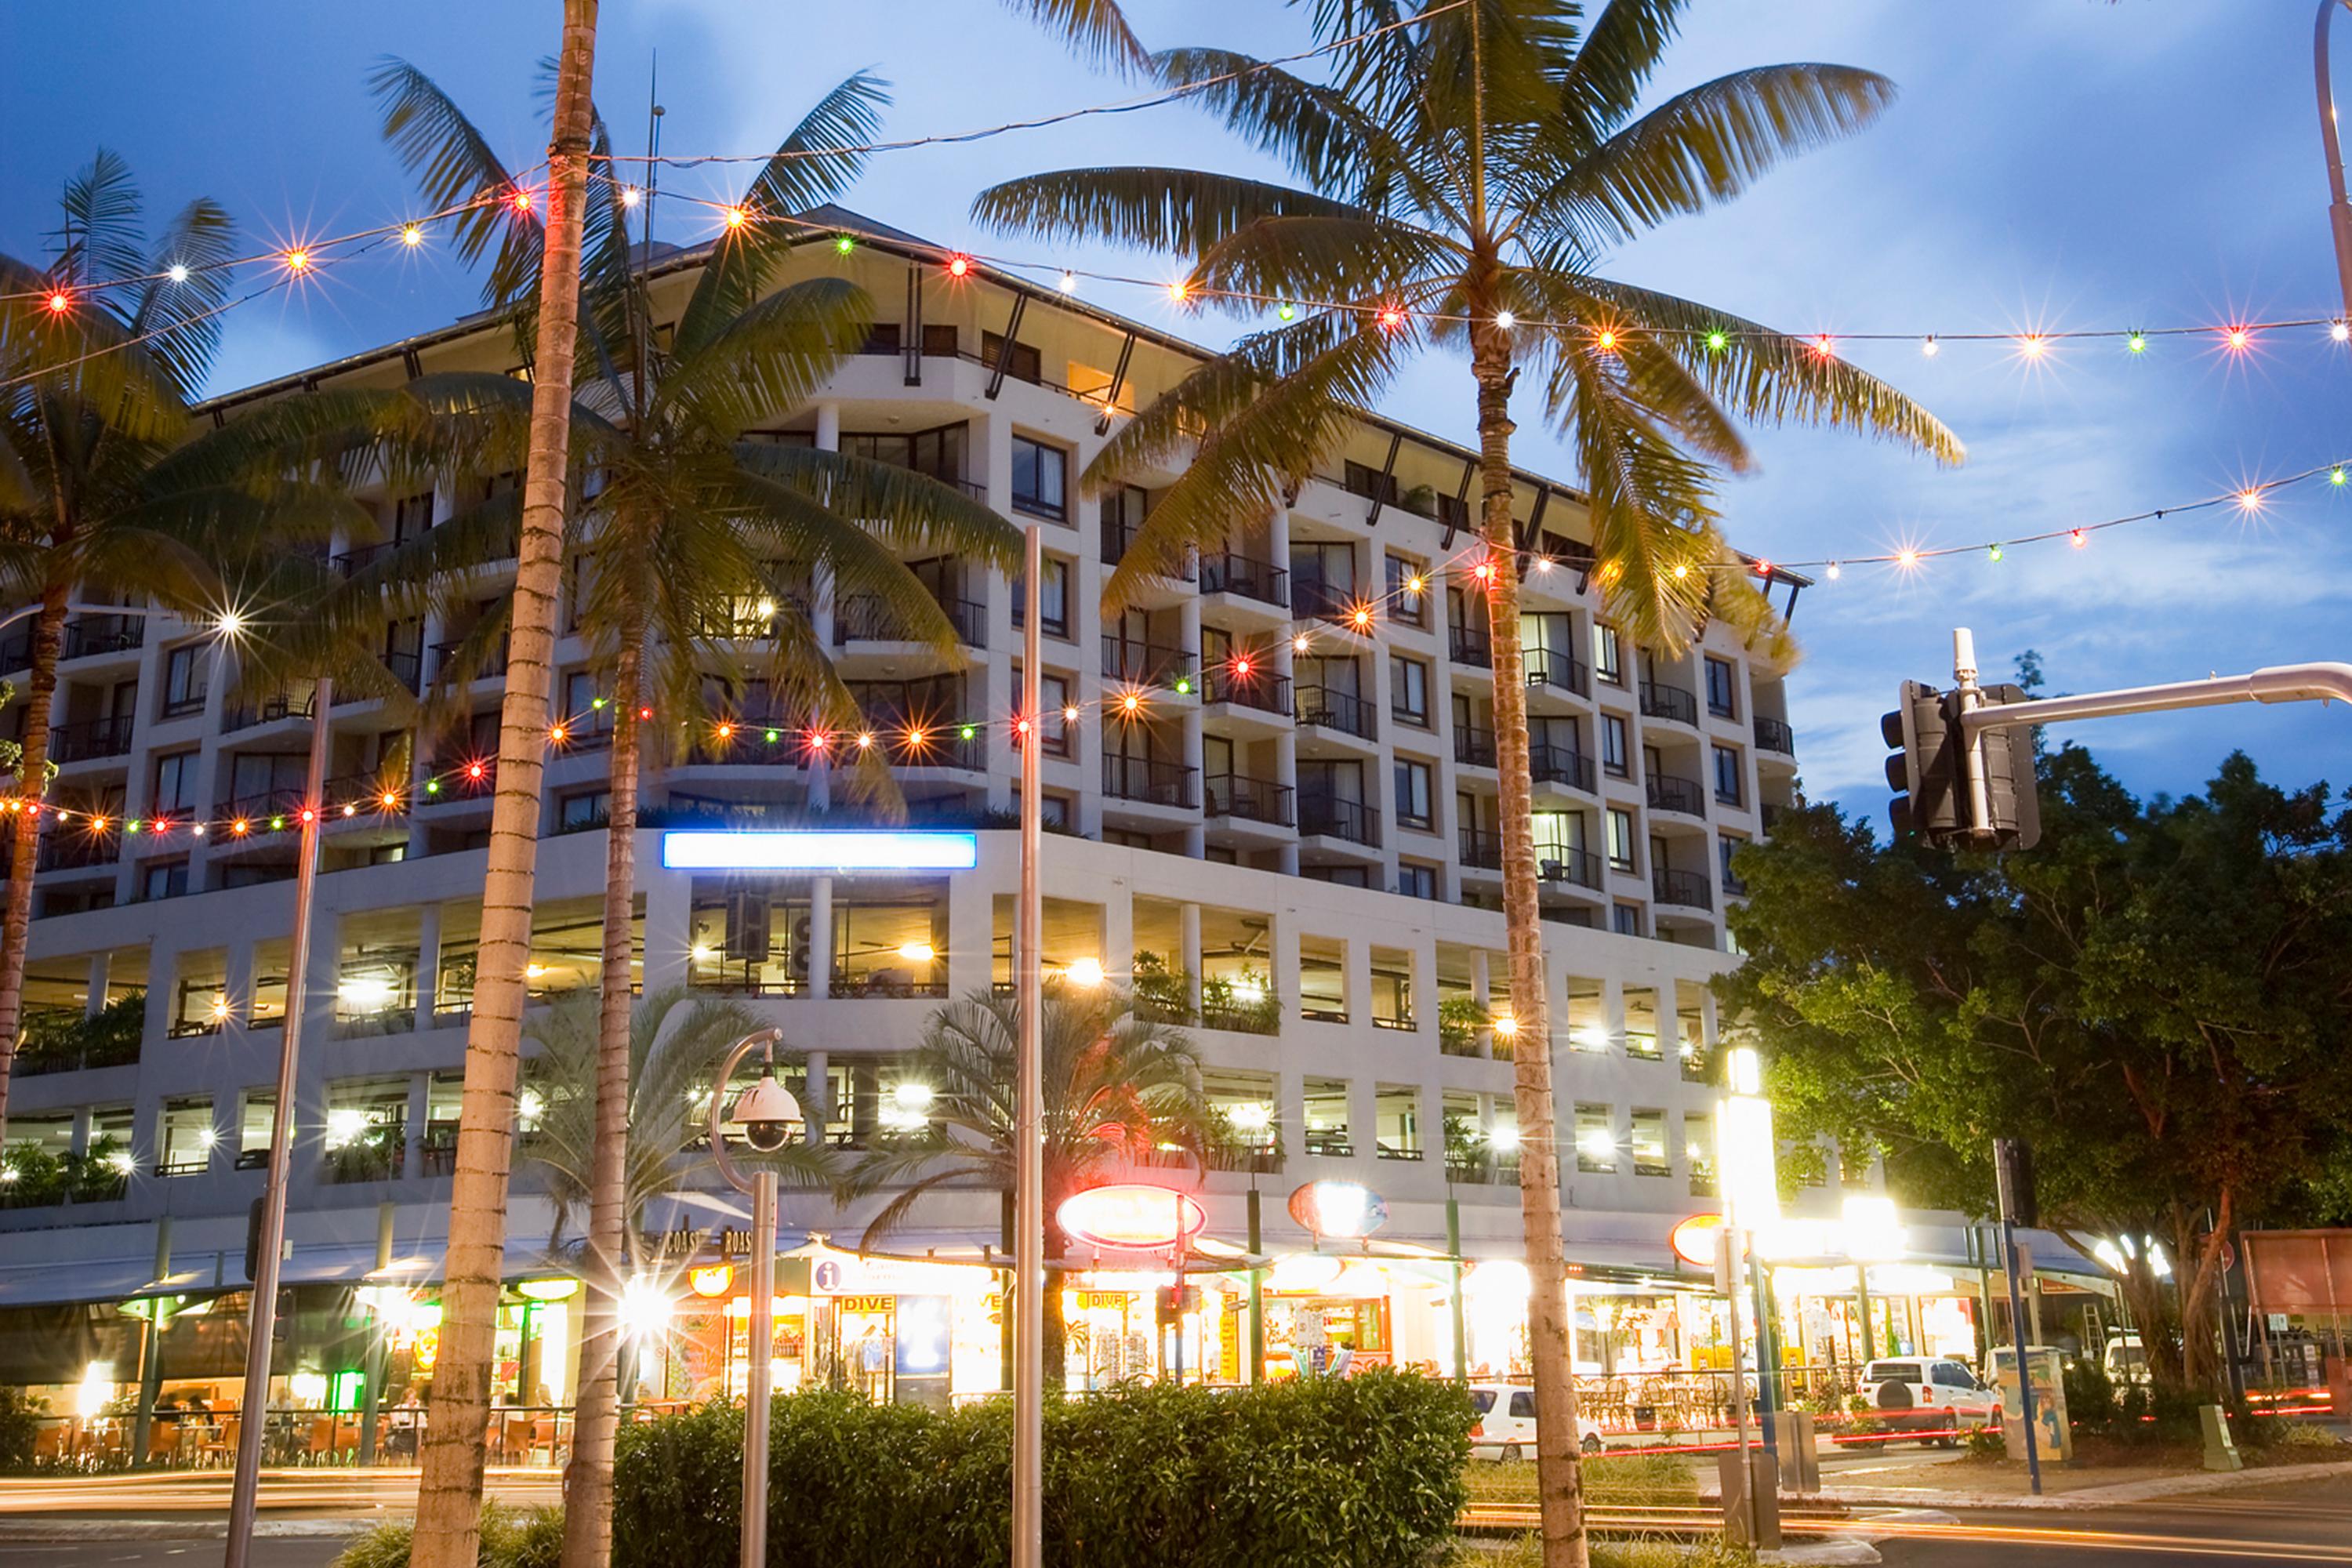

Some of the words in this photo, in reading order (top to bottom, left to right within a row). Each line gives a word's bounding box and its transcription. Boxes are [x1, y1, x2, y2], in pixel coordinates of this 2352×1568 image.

[724, 1231, 751, 1253] ROAS
[844, 1297, 892, 1310] DIVE
[1092, 1294, 1122, 1306] DIVE
